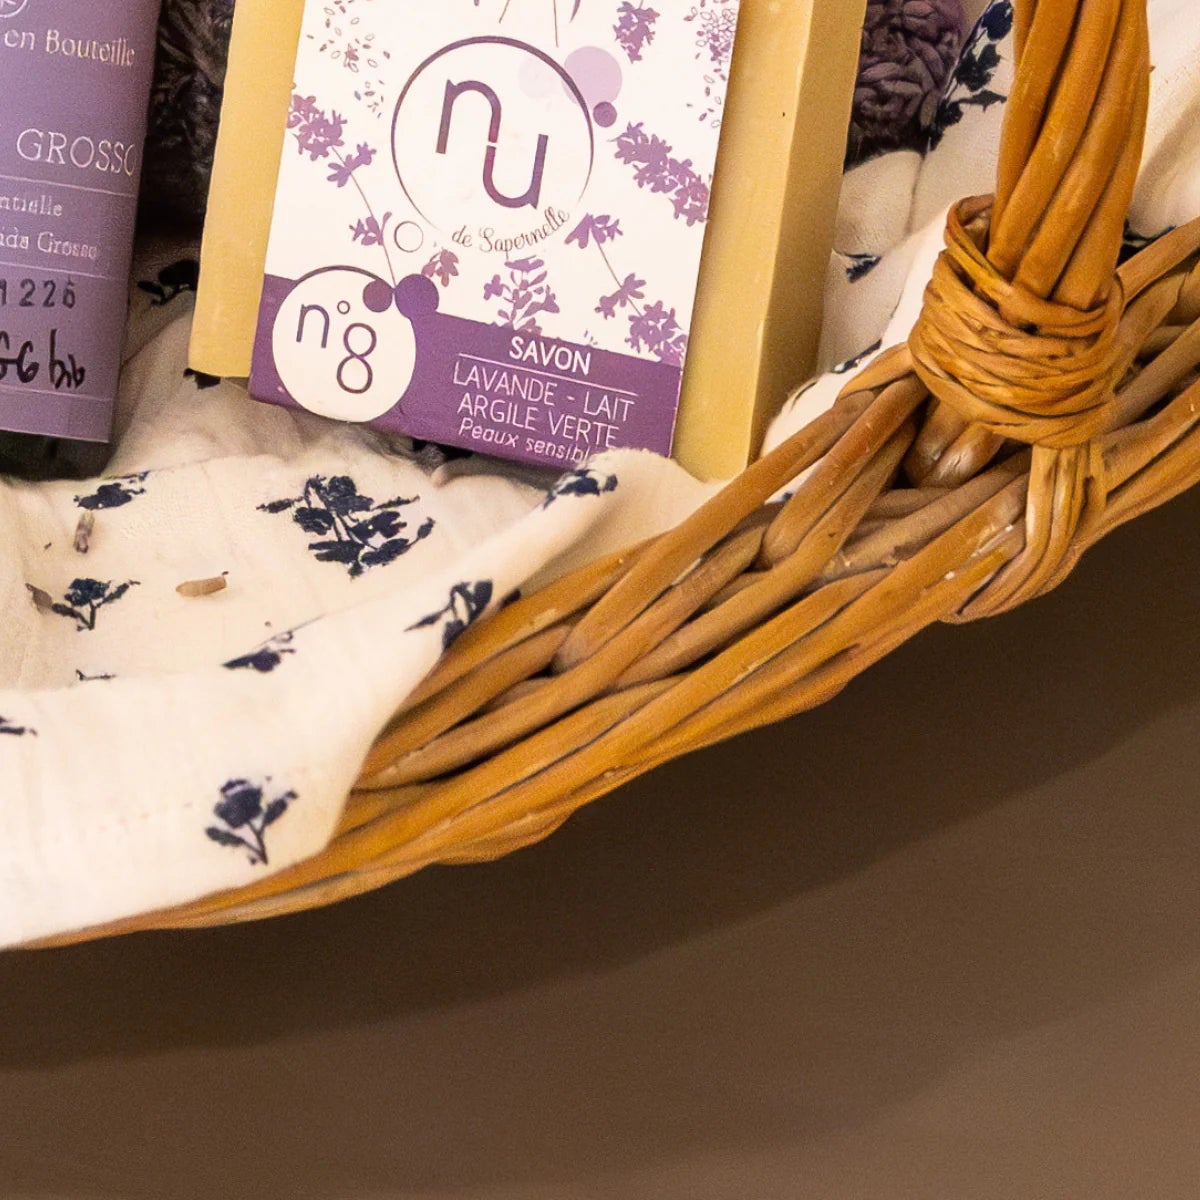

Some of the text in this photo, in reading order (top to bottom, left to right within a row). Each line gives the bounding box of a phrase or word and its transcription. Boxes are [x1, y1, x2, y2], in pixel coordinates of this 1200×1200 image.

[3, 28, 36, 50] en
[45, 28, 136, 67] Bouteille
[436, 78, 549, 210] nu
[451, 225, 473, 248] de
[508, 335, 591, 376] SAVON
[453, 360, 558, 407] LAVANDE
[583, 390, 635, 422] LAIT
[457, 392, 620, 449] ARGILE VERTE
[458, 417, 591, 464] Peaux sensibl
